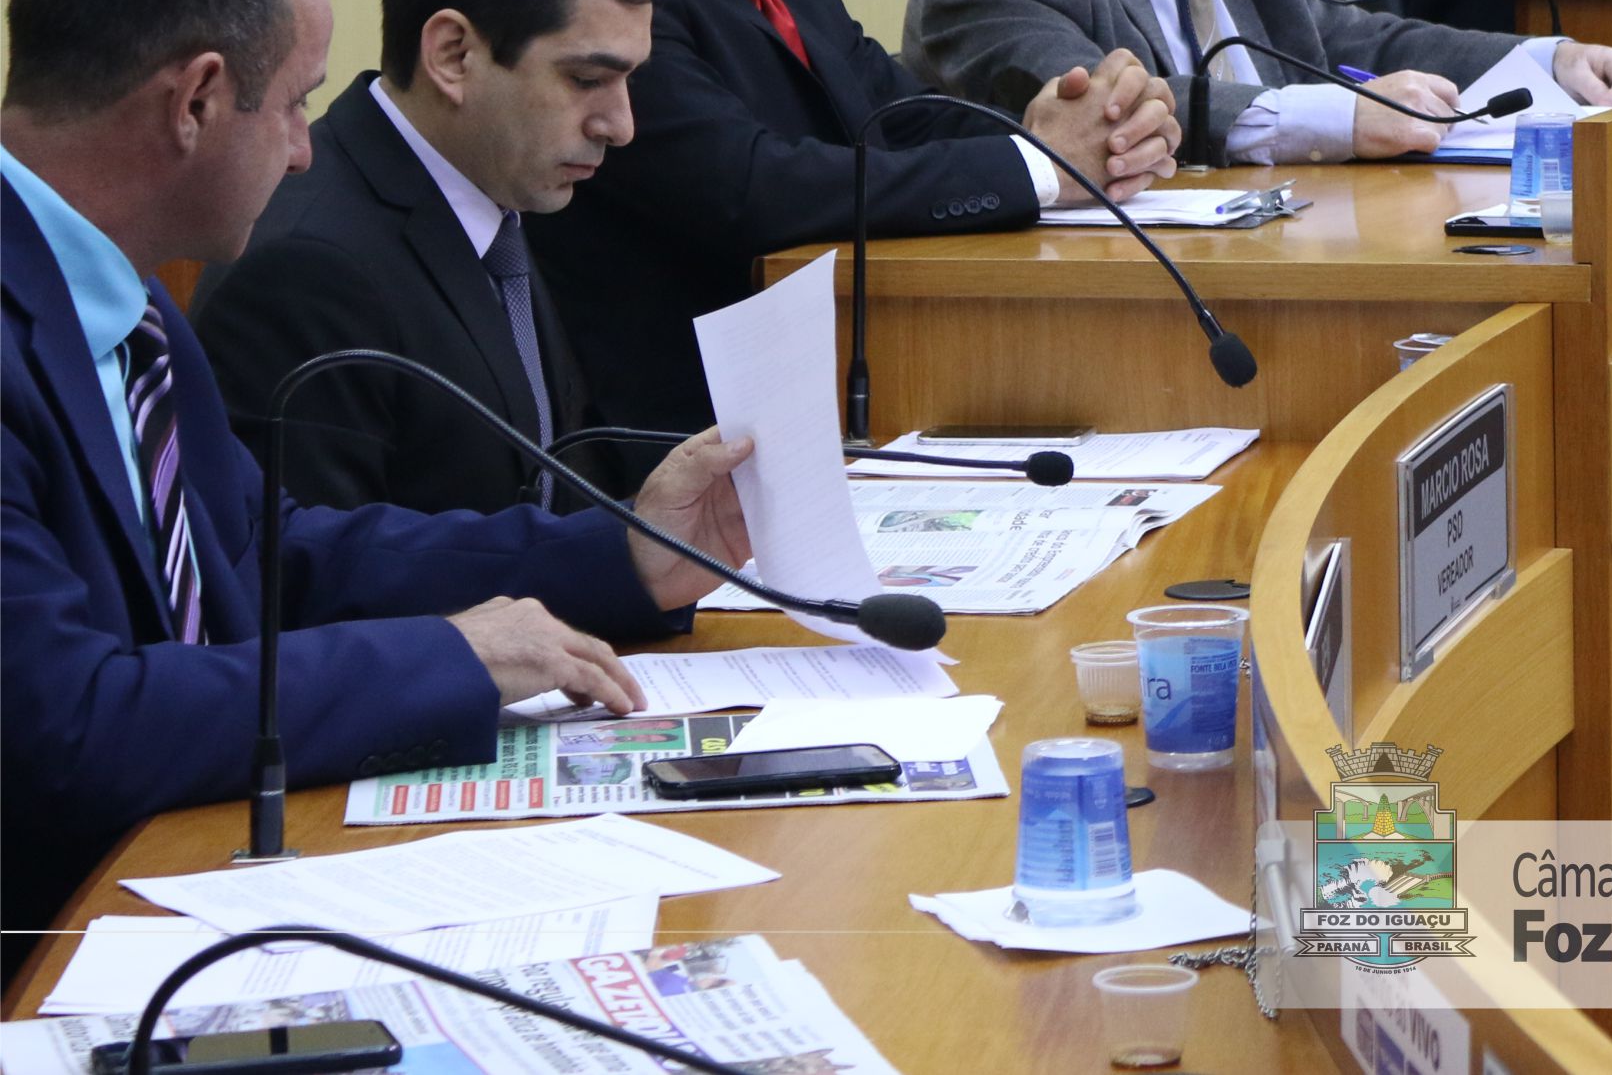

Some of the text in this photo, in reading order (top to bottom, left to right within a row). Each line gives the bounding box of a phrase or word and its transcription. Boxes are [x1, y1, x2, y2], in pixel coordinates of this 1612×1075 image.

[1421, 434, 1490, 520] MARCIO ROSA
[1447, 510, 1463, 549] PSD
[1437, 545, 1474, 597] VEREADOR
